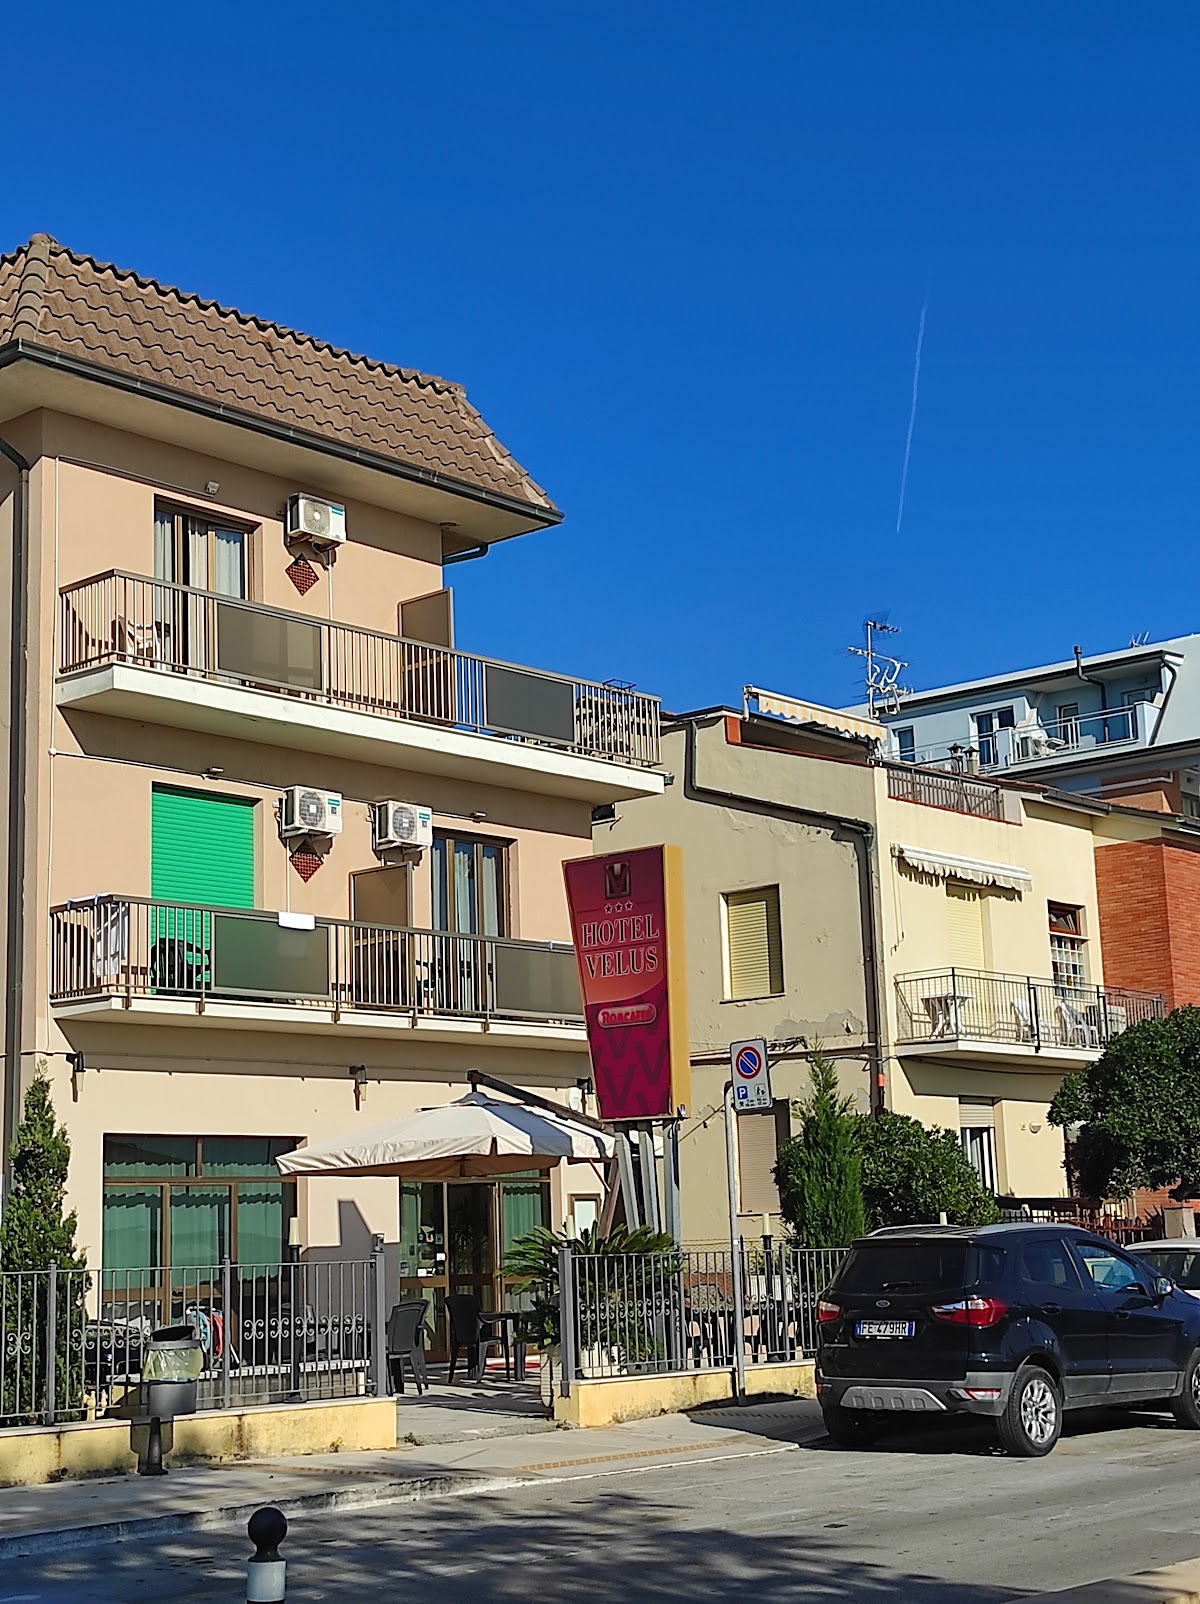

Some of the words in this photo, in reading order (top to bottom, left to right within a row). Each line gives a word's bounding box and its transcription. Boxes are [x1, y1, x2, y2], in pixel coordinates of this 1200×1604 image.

[581, 914, 660, 948] HOTEL
[585, 946, 658, 979] VELUS
[601, 1009, 652, 1024] ROMCAFF
[739, 1087, 746, 1098] P
